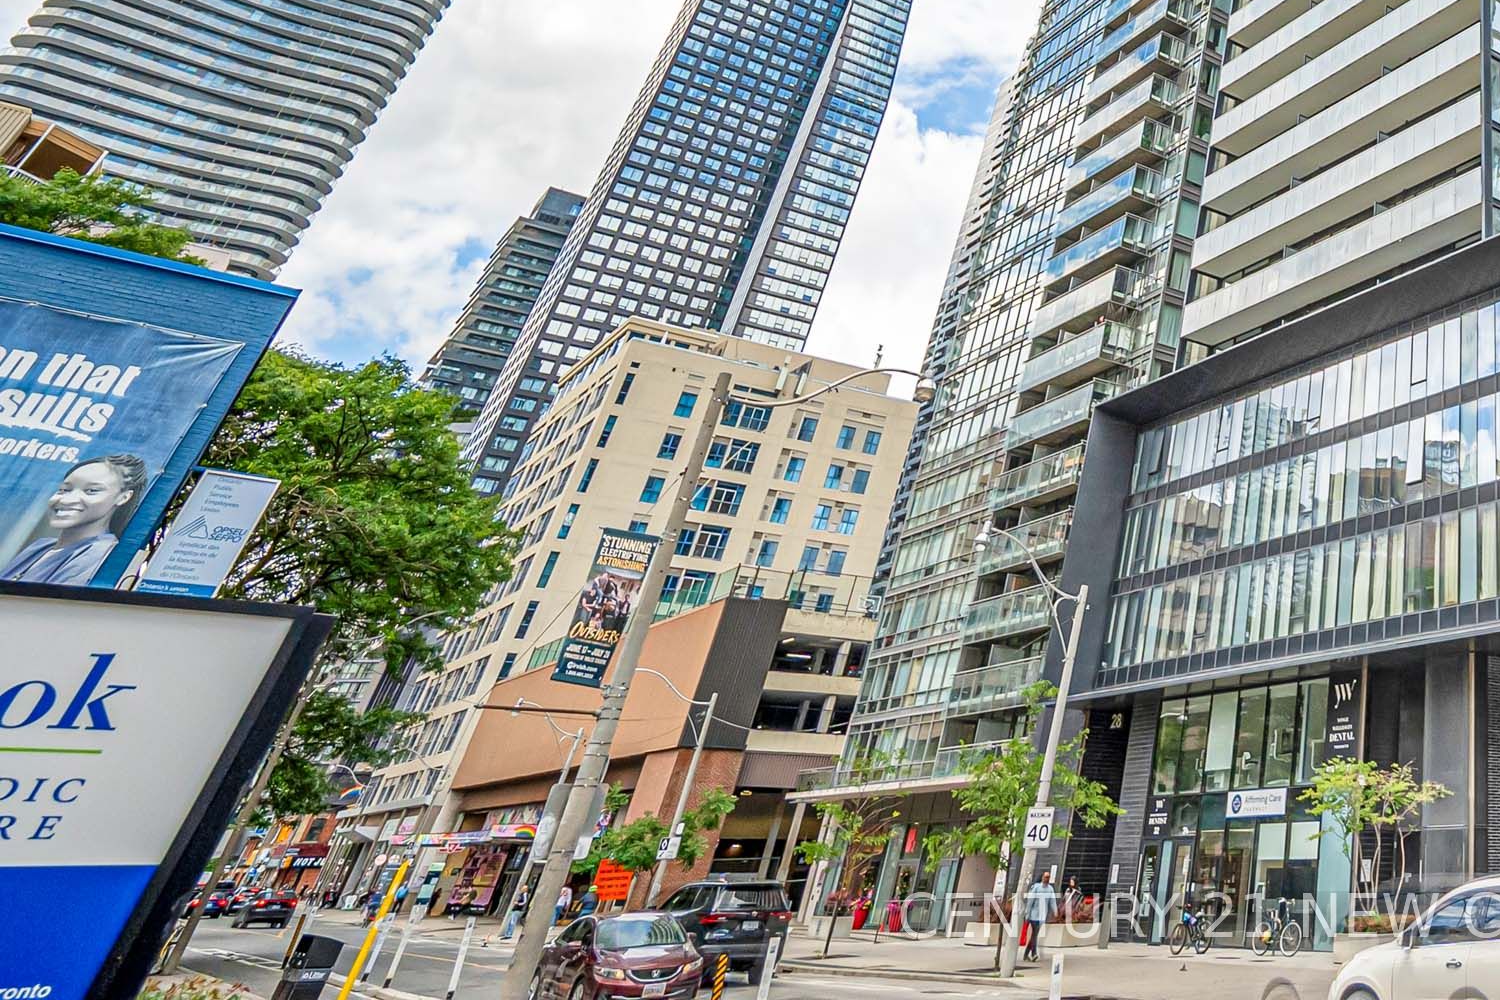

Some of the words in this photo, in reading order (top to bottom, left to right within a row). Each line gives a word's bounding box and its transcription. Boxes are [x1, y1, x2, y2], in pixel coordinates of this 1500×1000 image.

[0, 346, 38, 380] n
[38, 353, 141, 397] that
[0, 388, 115, 433] sults
[0, 437, 80, 463] orkers.
[207, 533, 242, 543] SEFPO
[213, 526, 248, 536] OPSEU
[0, 653, 137, 731] ok
[1110, 713, 1122, 728] 28
[1329, 731, 1355, 742] DENTAL
[1027, 824, 1049, 842] 40
